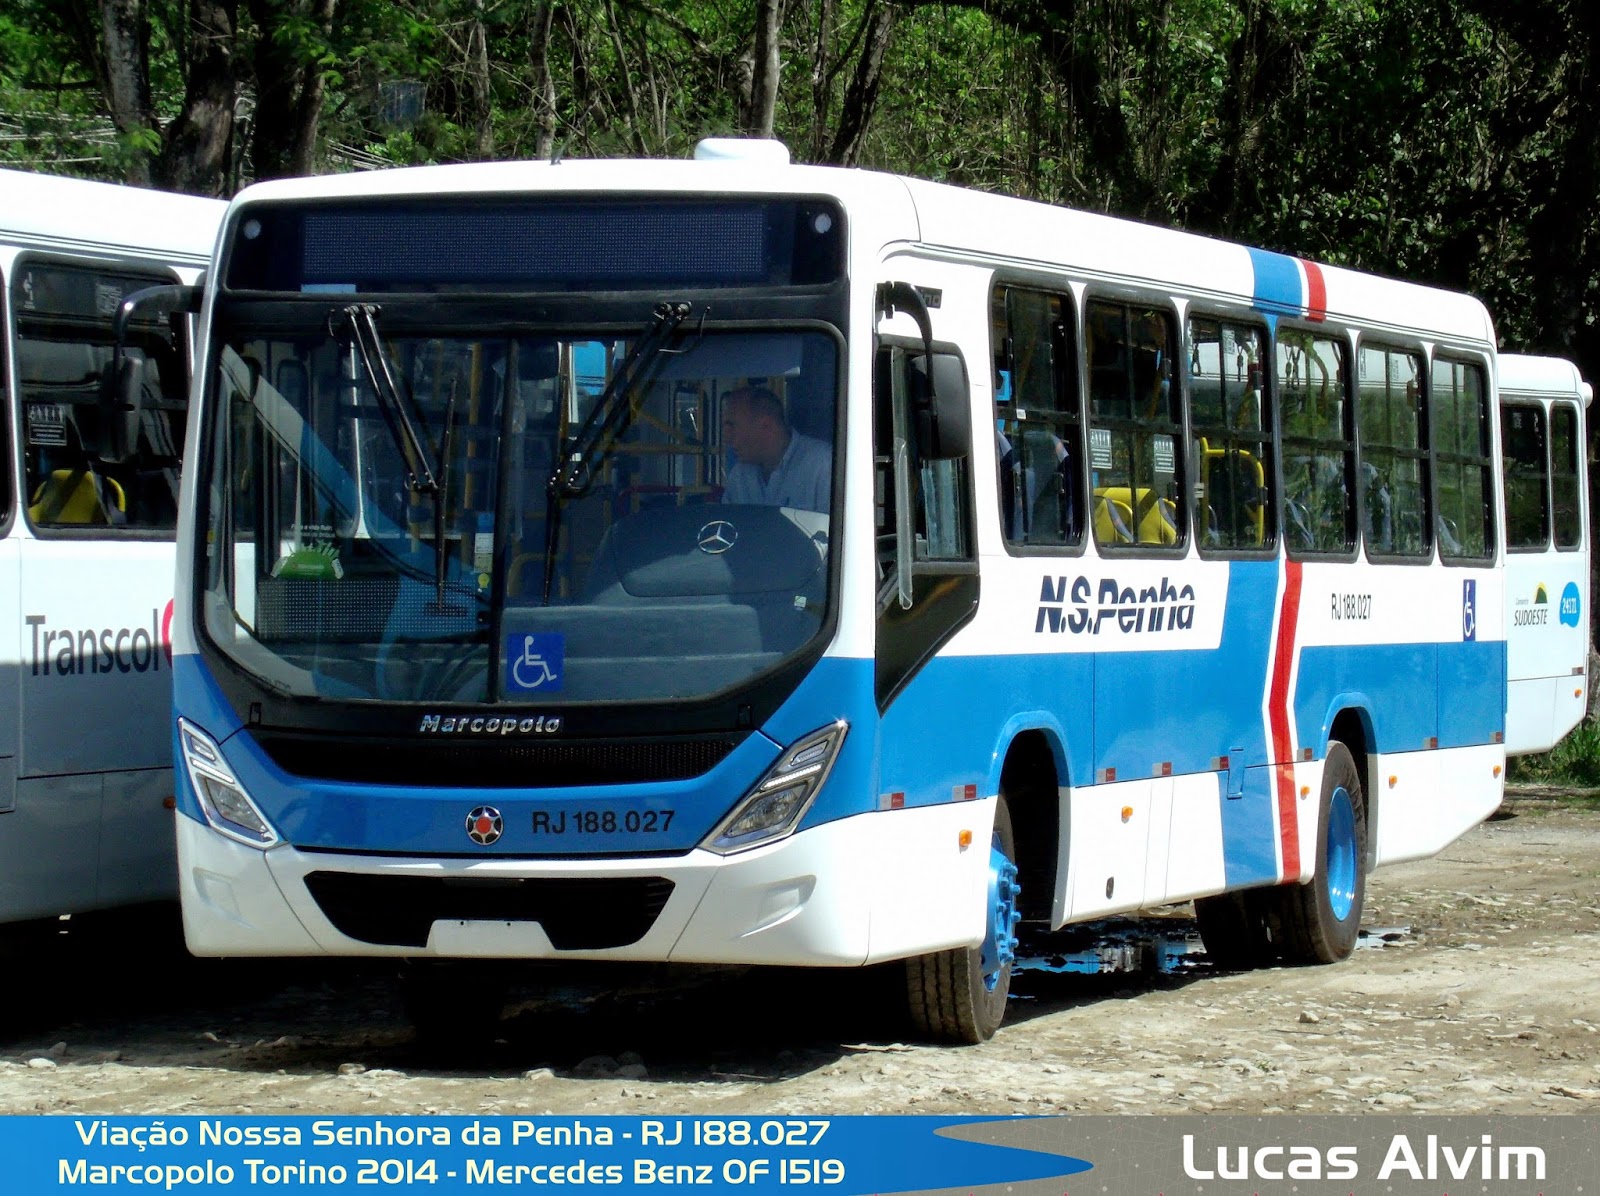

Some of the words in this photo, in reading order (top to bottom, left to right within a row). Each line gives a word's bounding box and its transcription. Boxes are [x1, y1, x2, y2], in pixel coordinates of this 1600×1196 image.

[1035, 575, 1195, 634] N.S.Penha
[1331, 593, 1341, 620] RJ
[1343, 594, 1371, 620] 188.027
[1514, 609, 1548, 626] SUDOESTE
[419, 714, 561, 735] Marcopolo
[532, 811, 566, 833] RJ
[573, 810, 675, 833] 188.027
